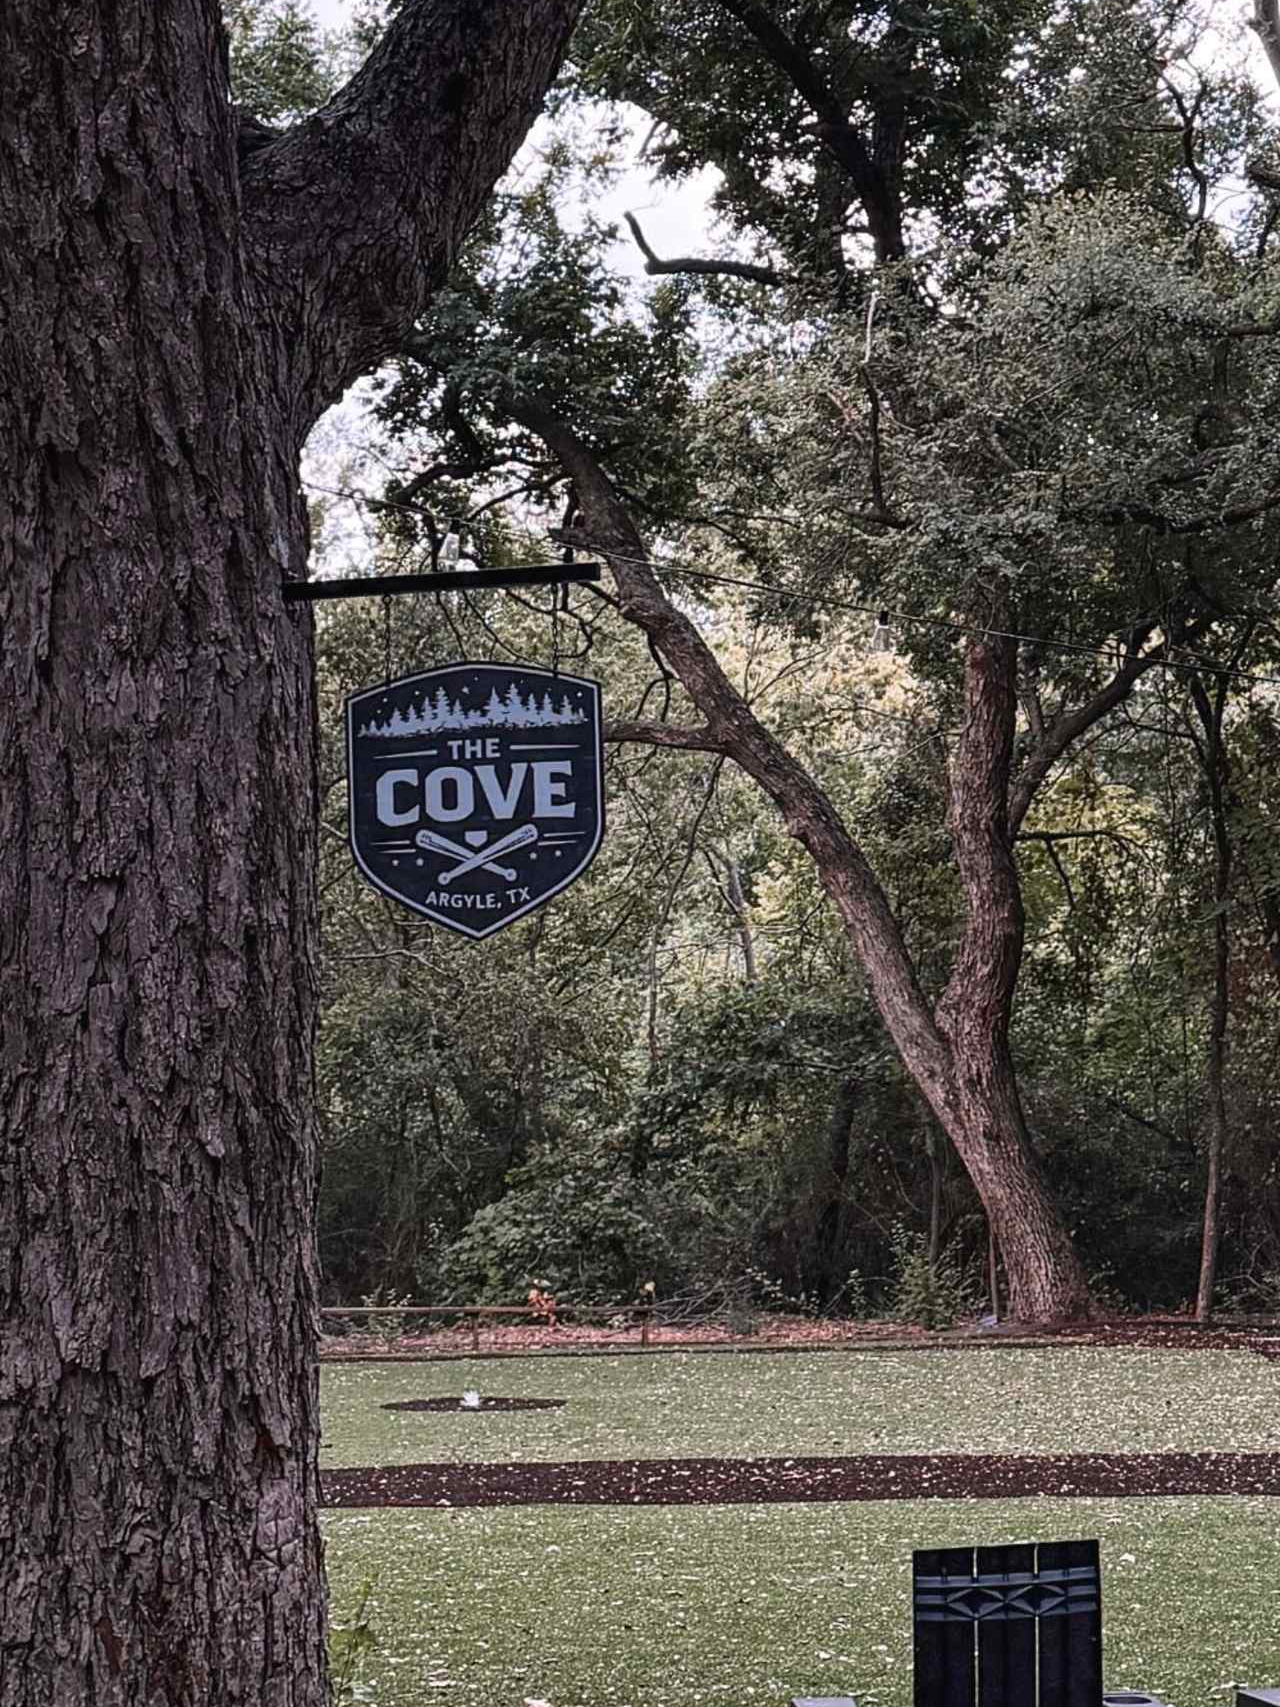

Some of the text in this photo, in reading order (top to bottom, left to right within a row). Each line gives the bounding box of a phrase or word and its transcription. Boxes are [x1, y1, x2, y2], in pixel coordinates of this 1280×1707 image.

[448, 738, 501, 760] THE
[376, 760, 576, 827] COVE
[425, 887, 530, 909] ARGYLE, TX
